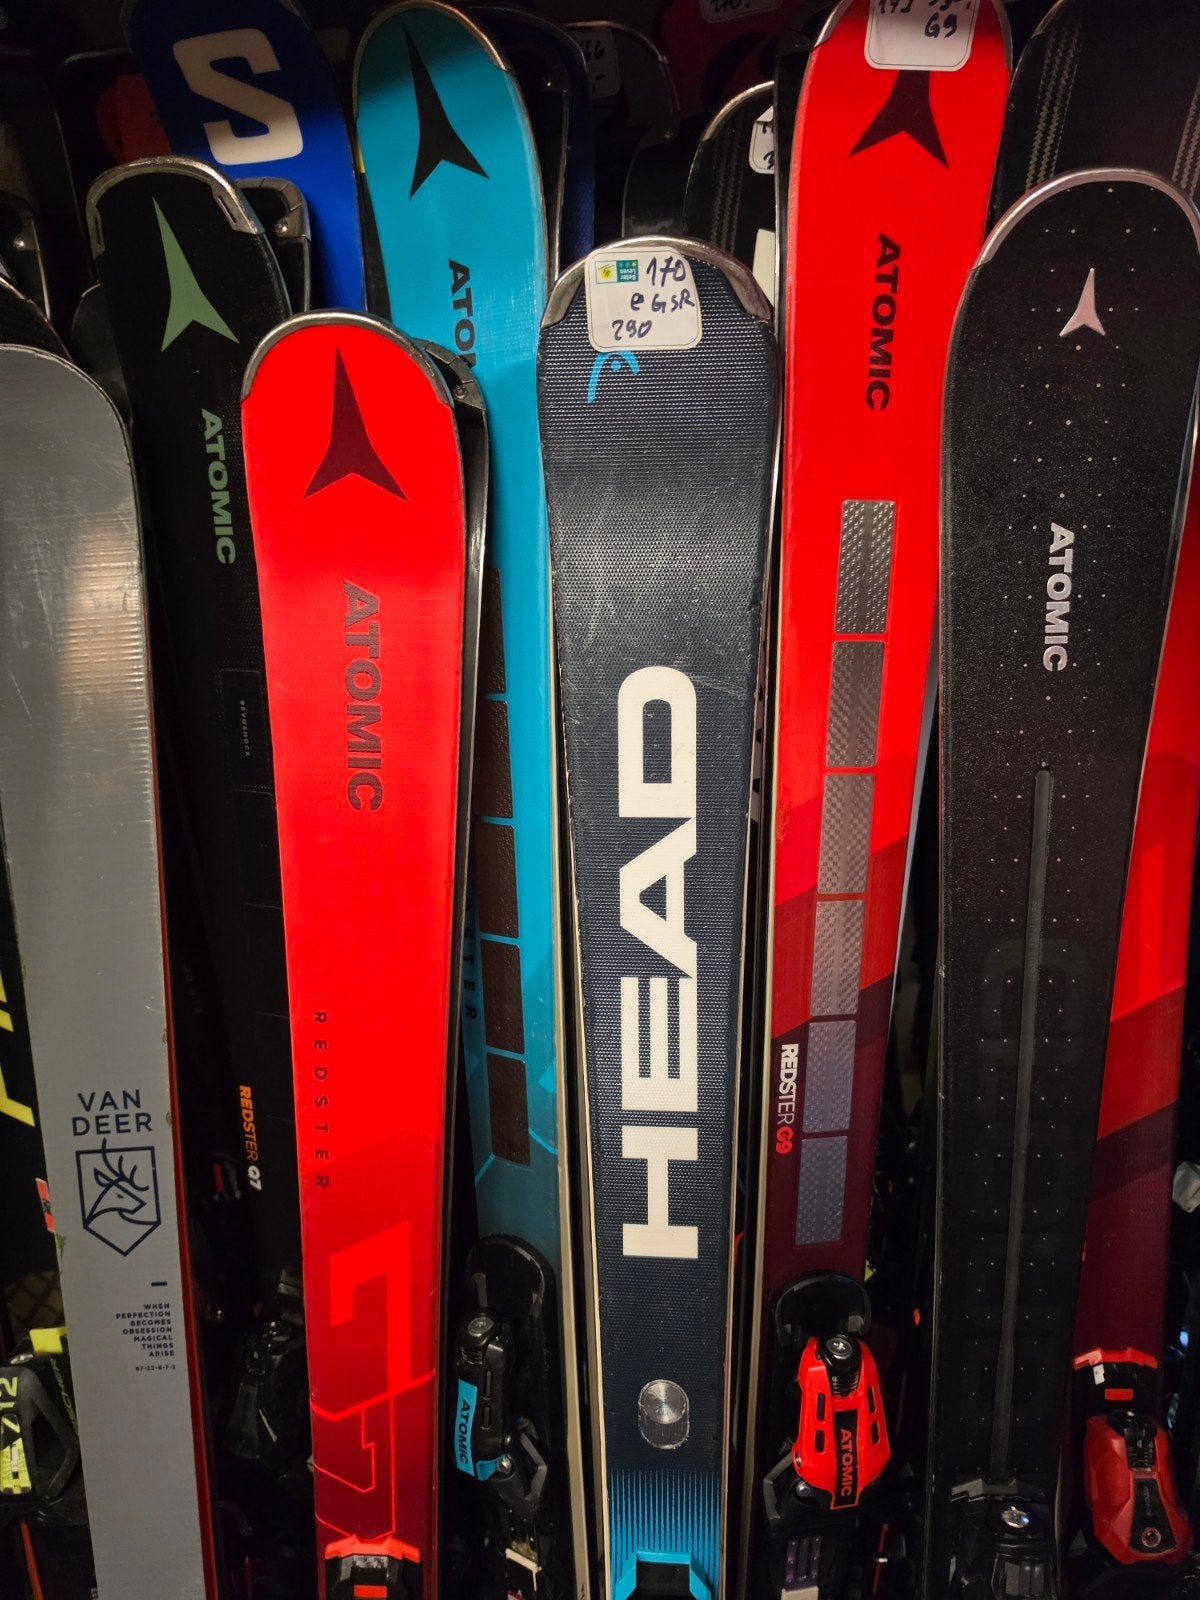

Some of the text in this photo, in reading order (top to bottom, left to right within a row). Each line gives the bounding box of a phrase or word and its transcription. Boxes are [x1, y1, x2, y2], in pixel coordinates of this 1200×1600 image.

[925, 12, 957, 38] G9
[646, 256, 686, 287] 170
[448, 259, 477, 368] ATO
[867, 233, 900, 409] ATOMIC
[201, 408, 236, 565] ATOMIC
[1043, 522, 1077, 673] ATOMIC
[341, 579, 386, 813] ATOMIC
[618, 665, 699, 1259] HEAD
[71, 1113, 153, 1137] DEER
[77, 1089, 141, 1113] VAN
[238, 1085, 259, 1162] REDSTER
[312, 1009, 331, 1190] REDSTER
[775, 1043, 800, 1156] REDSTER G9
[115, 1311, 171, 1319] PERFECTION
[122, 1327, 172, 1335] OBSESSION
[130, 1319, 171, 1327] BECOMES
[143, 1302, 170, 1310] WHEN
[141, 1342, 174, 1350] THINGS
[457, 1401, 472, 1467] ATOMIC
[840, 1427, 853, 1498] ATOMIC
